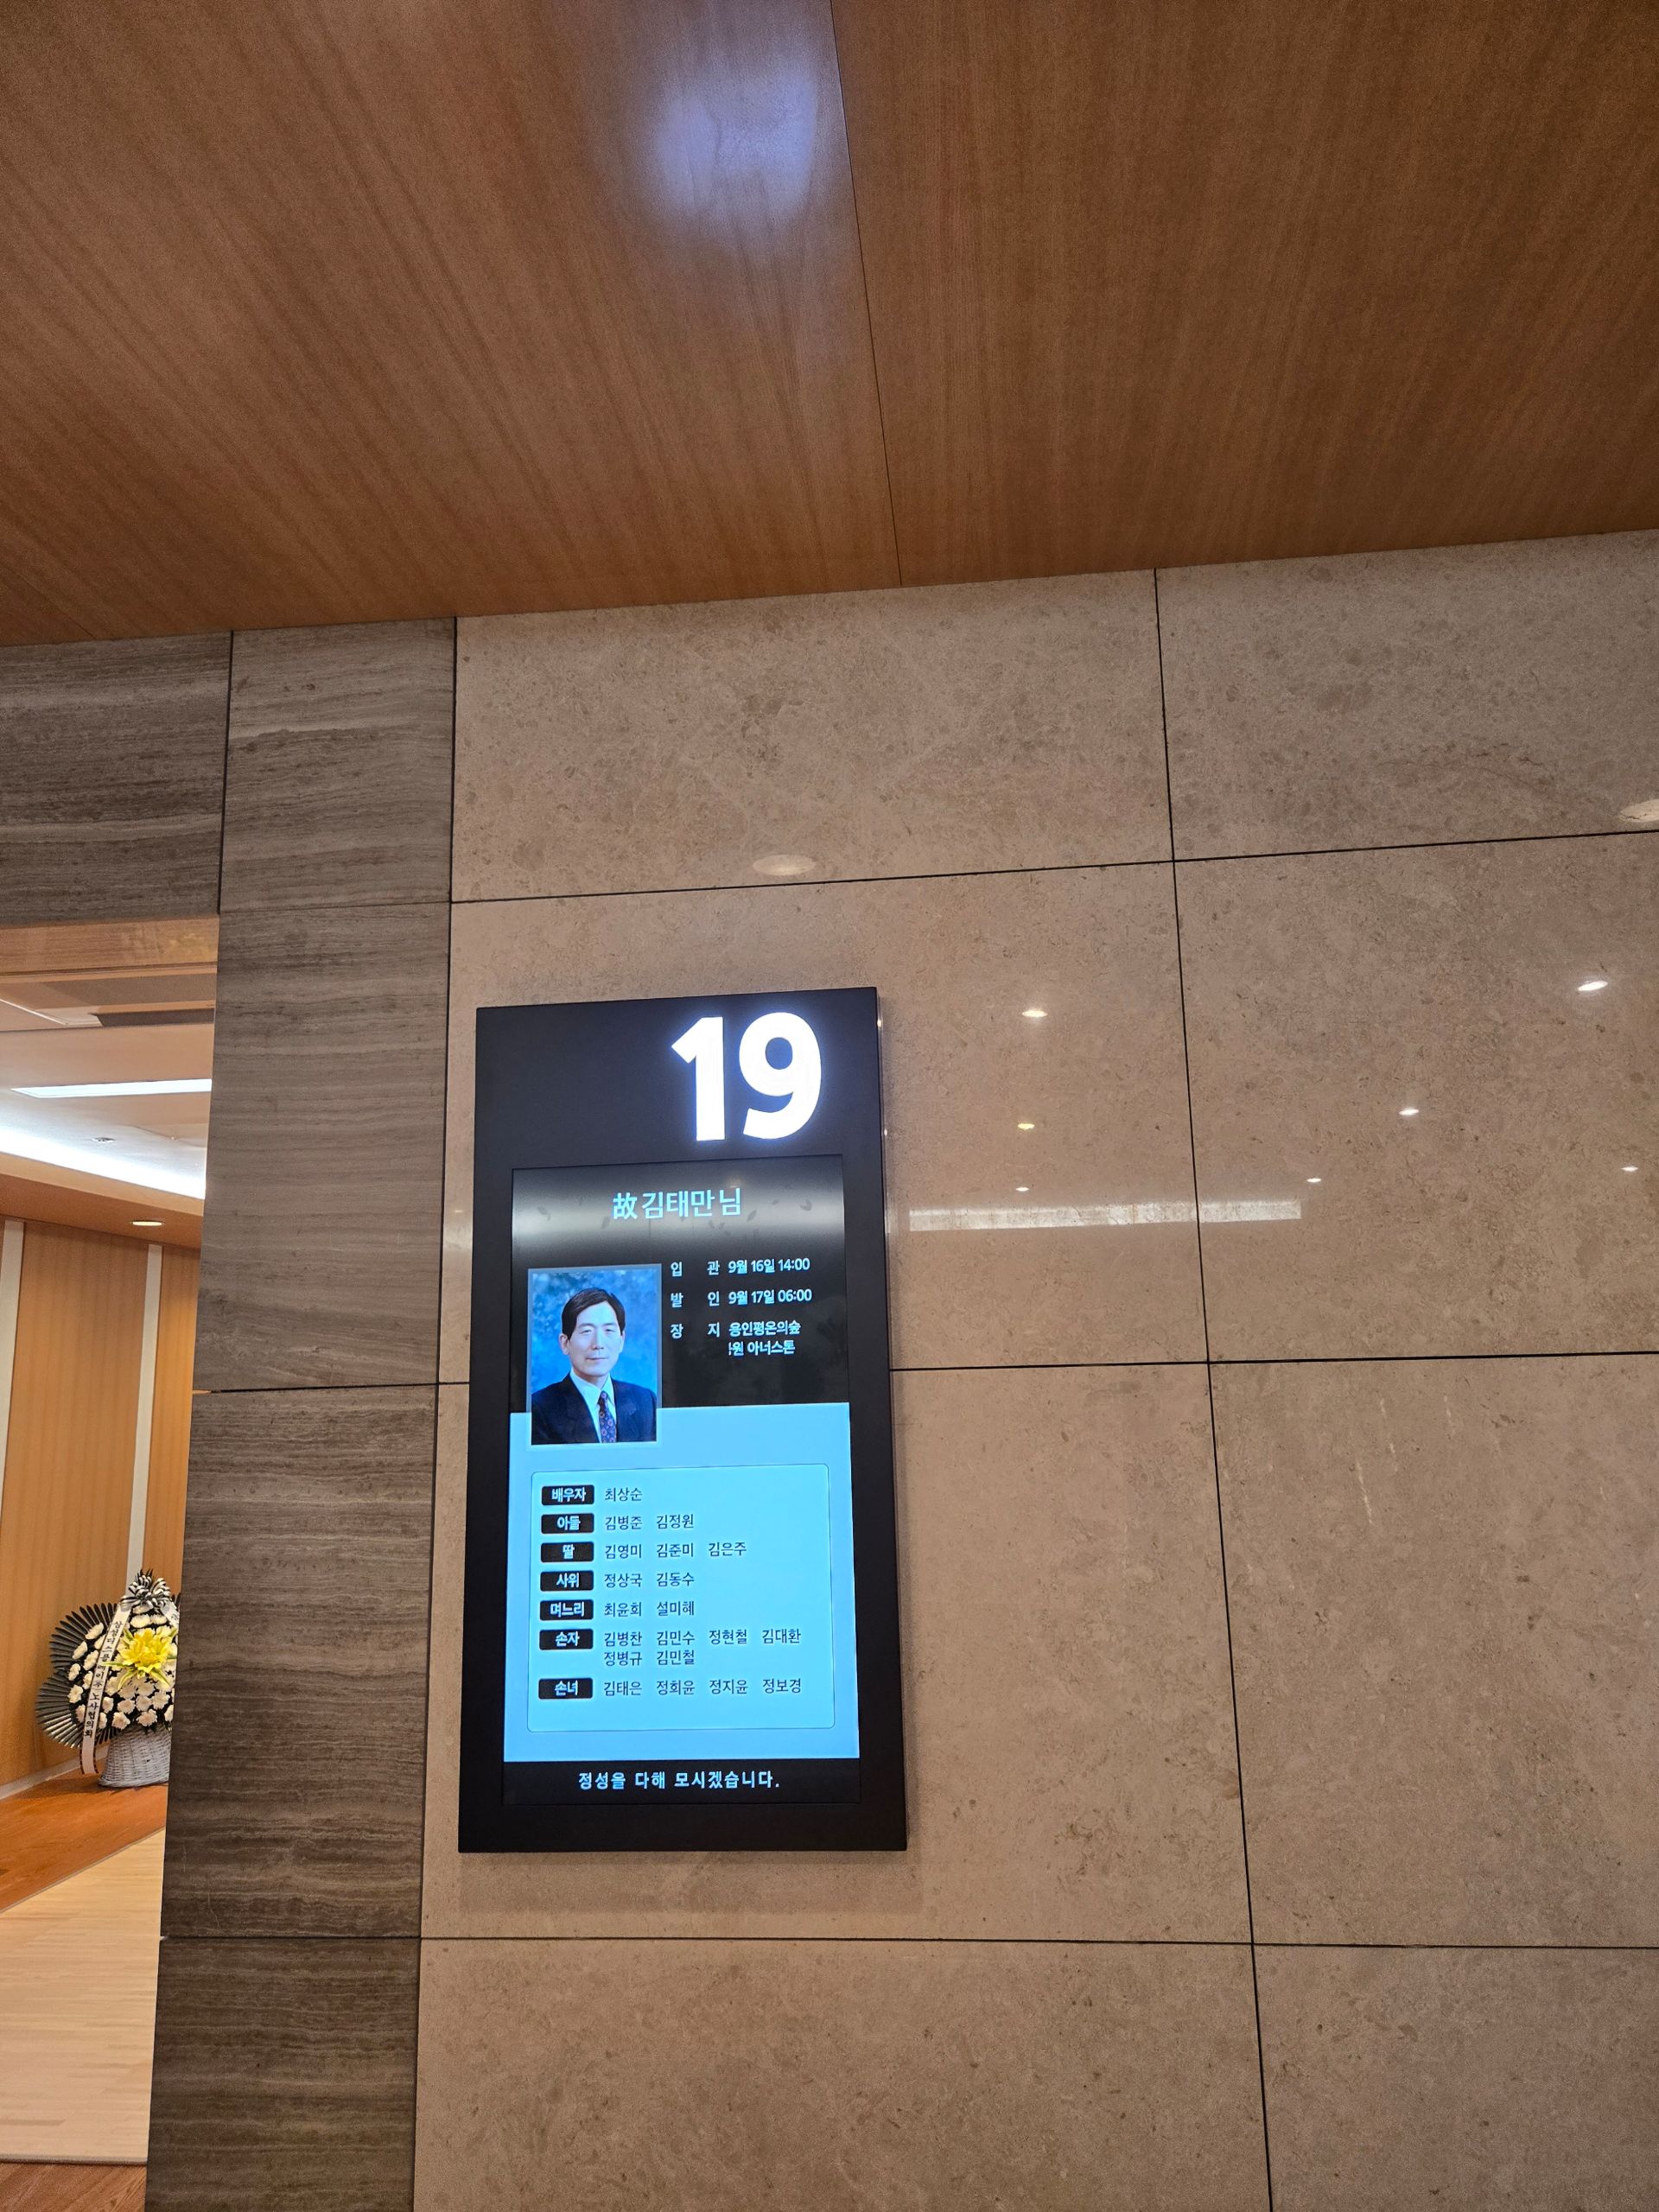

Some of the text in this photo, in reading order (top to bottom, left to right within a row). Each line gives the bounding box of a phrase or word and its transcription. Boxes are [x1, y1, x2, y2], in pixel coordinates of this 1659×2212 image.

[671, 1011, 822, 1141] 19
[613, 1188, 741, 1219] 故 김태만 님
[671, 1258, 810, 1277] 입 관 9월 16일 14:00
[671, 1289, 812, 1307] 발 인 9월 17일 06:00
[671, 1320, 801, 1338] 장 지 용인평온의숲
[747, 1340, 795, 1356] 아너스톤
[551, 1487, 642, 1503] 배우자 최상순
[557, 1514, 694, 1530] 아들 김병준 김정원
[563, 1542, 747, 1559] 딸 김영미 김준미 김은주
[556, 1573, 695, 1588] 사위 정상국 김동수
[550, 1603, 584, 1617] 며느리
[657, 1601, 694, 1616] 설미혜
[556, 1630, 801, 1647] 손자 김병찬 김민수 정현철 김대환
[604, 1650, 695, 1666] 정병규 김민철
[555, 1681, 578, 1696] 손녀
[604, 1681, 642, 1696] 김태은
[709, 1680, 748, 1694] 정지윤
[763, 1679, 801, 1694] 정보경
[579, 1770, 779, 1789] 정성을 다해 모시겠습니다.
